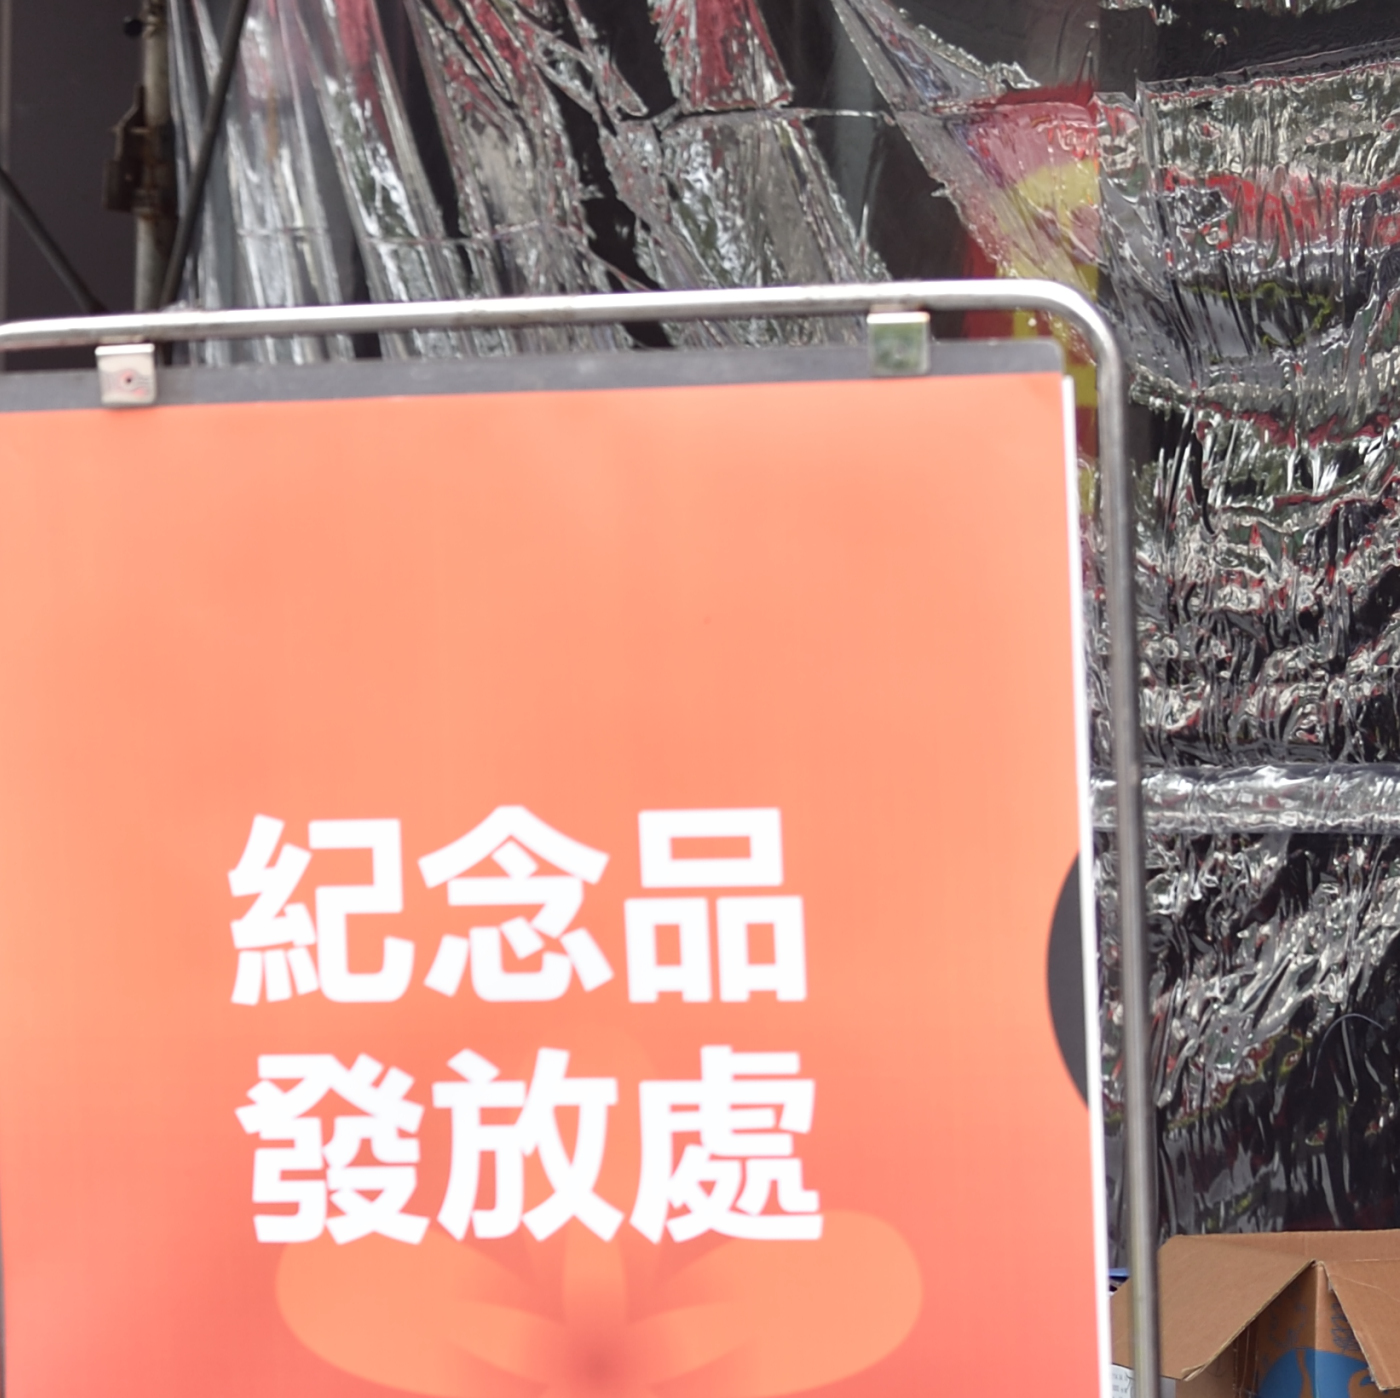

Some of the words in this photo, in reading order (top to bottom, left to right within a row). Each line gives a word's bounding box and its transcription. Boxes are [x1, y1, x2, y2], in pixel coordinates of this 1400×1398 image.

[228, 804, 807, 1006] 紀念品
[235, 1044, 824, 1245] 發放處
